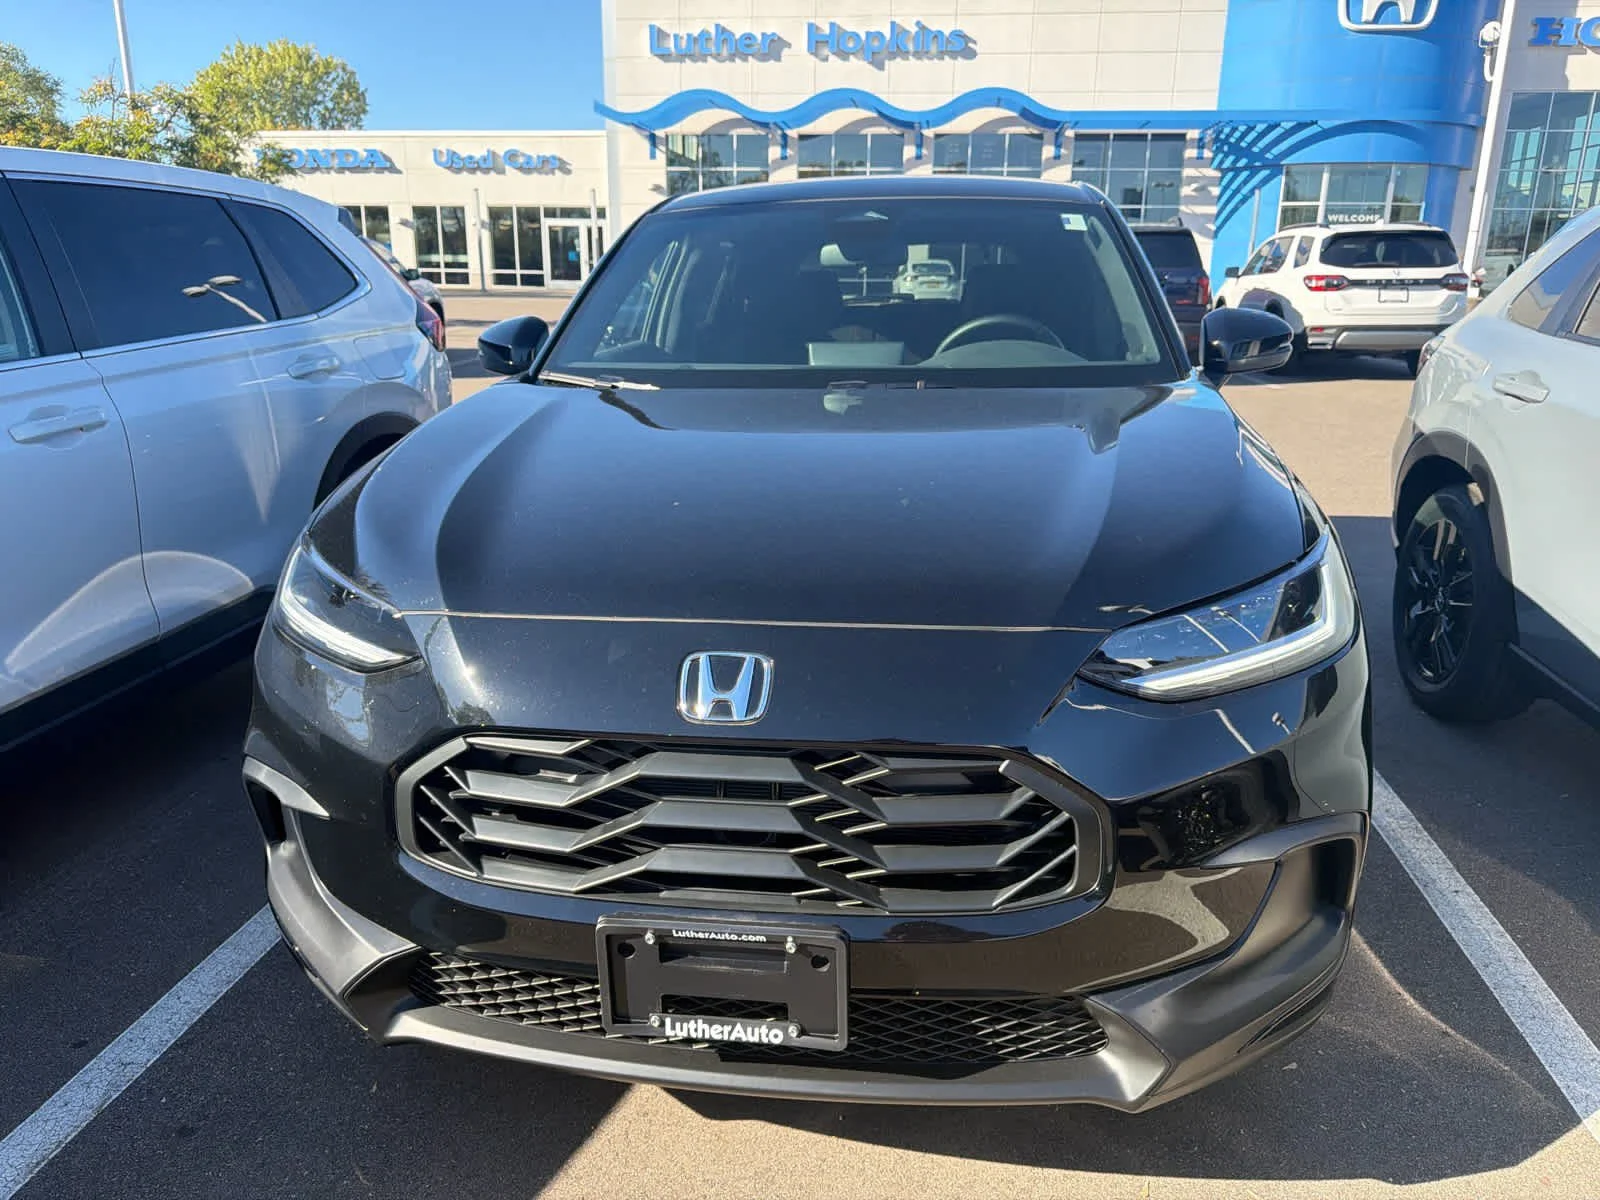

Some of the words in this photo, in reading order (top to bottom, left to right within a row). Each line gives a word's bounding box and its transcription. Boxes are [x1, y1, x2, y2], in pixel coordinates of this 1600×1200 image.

[649, 23, 778, 55] Luther
[807, 20, 967, 61] Hopkins
[432, 148, 493, 169] Used
[503, 149, 558, 170] Cars
[672, 929, 767, 943] LutherAuto.com
[664, 1016, 784, 1045] LutherAuto
